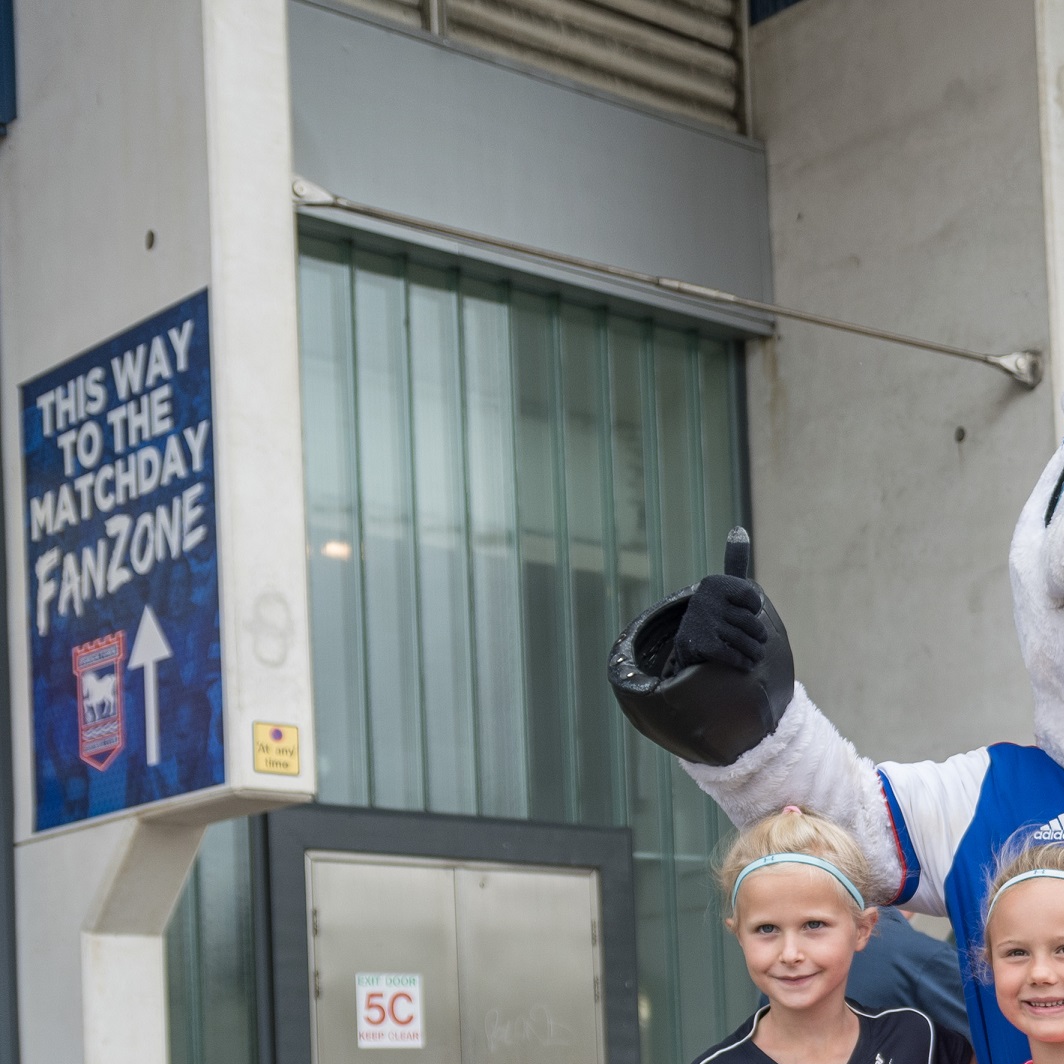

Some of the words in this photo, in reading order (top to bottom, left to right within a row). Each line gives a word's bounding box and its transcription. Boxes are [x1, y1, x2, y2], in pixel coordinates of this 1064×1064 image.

[37, 366, 108, 437] THIS
[111, 318, 194, 400] WAY
[58, 428, 100, 477] TO
[107, 383, 173, 446] THE
[30, 419, 210, 543] MATCHDAY
[35, 481, 209, 637] FANZONE
[357, 976, 380, 986] EXIT
[385, 975, 416, 986] DOOR
[364, 991, 414, 1026] 5C
[359, 1031, 385, 1041] KEEP
[387, 1031, 419, 1041] CLEAR
